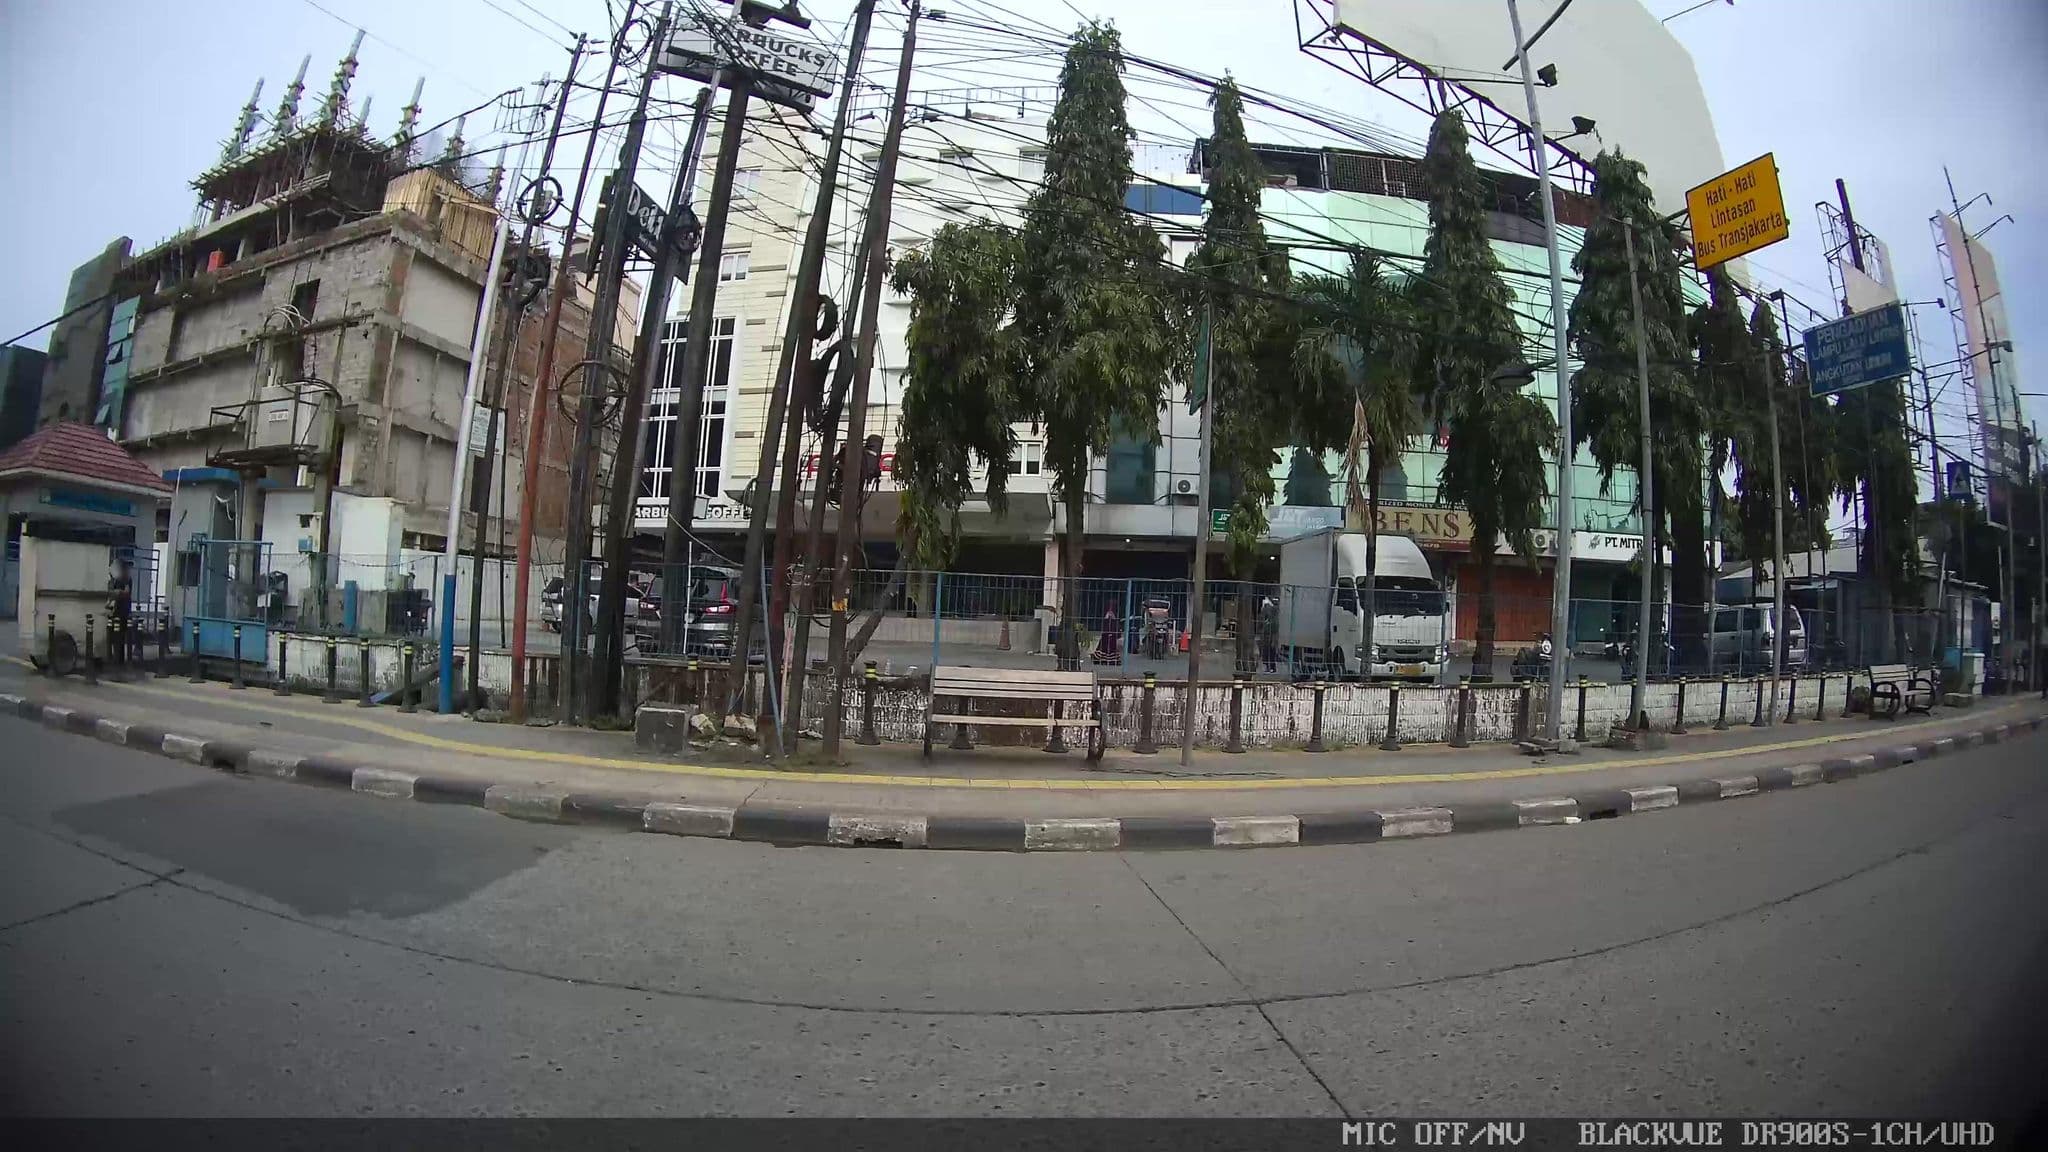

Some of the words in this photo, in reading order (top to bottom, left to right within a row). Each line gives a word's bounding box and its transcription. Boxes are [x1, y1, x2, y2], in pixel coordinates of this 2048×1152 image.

[1706, 183, 1728, 207] Hati
[1734, 170, 1757, 194] Hati
[1710, 198, 1757, 229] Lintasan
[1697, 239, 1717, 258] Bus
[1718, 211, 1783, 245] Transjakarta
